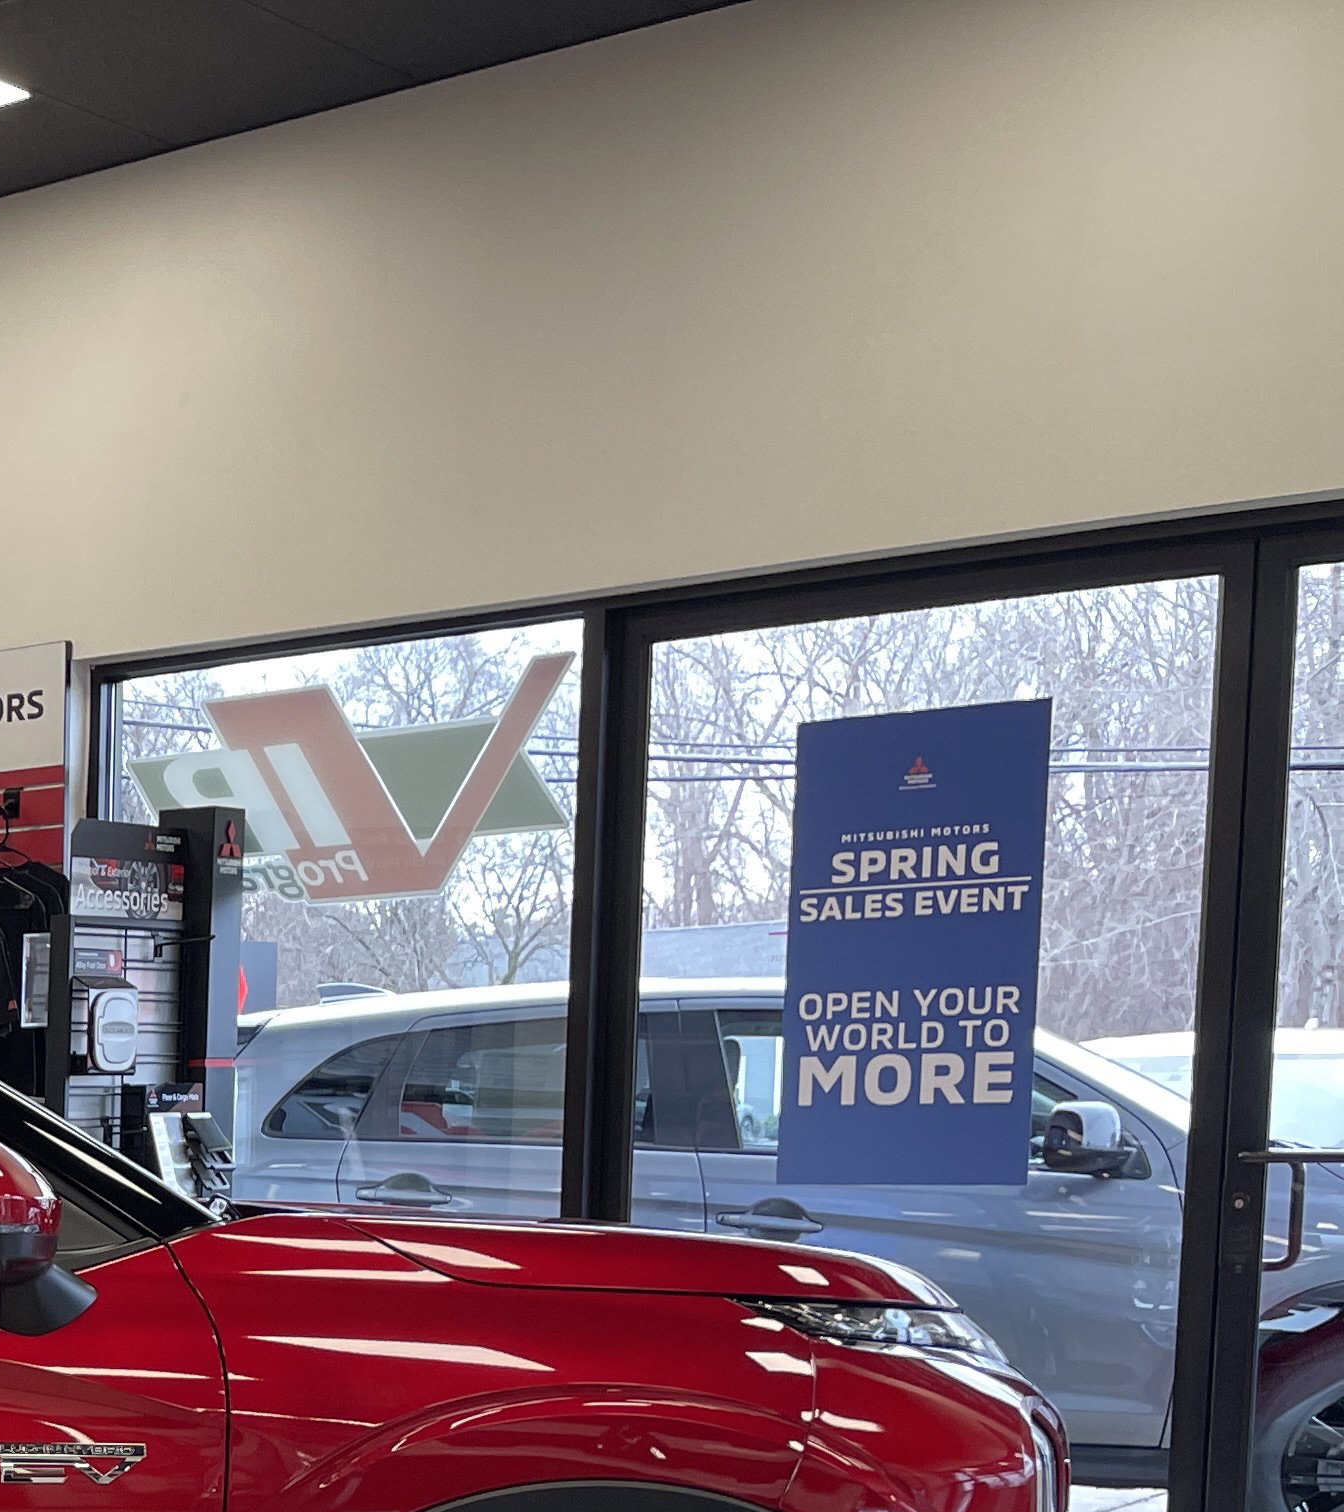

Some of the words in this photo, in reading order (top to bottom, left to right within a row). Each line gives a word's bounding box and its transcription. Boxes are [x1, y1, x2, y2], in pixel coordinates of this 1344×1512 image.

[841, 828, 924, 844] MITSUBISHI
[931, 823, 990, 838] MOTORS
[831, 841, 999, 884] SPRING
[75, 883, 169, 913] Accessories
[799, 892, 904, 922] SALES
[915, 885, 1029, 916] EVENT
[798, 990, 899, 1021] OPEN
[913, 985, 1021, 1017] YOUR
[805, 1021, 945, 1052] WORLD
[958, 1018, 1010, 1048] TO
[797, 1050, 1015, 1106] MORE
